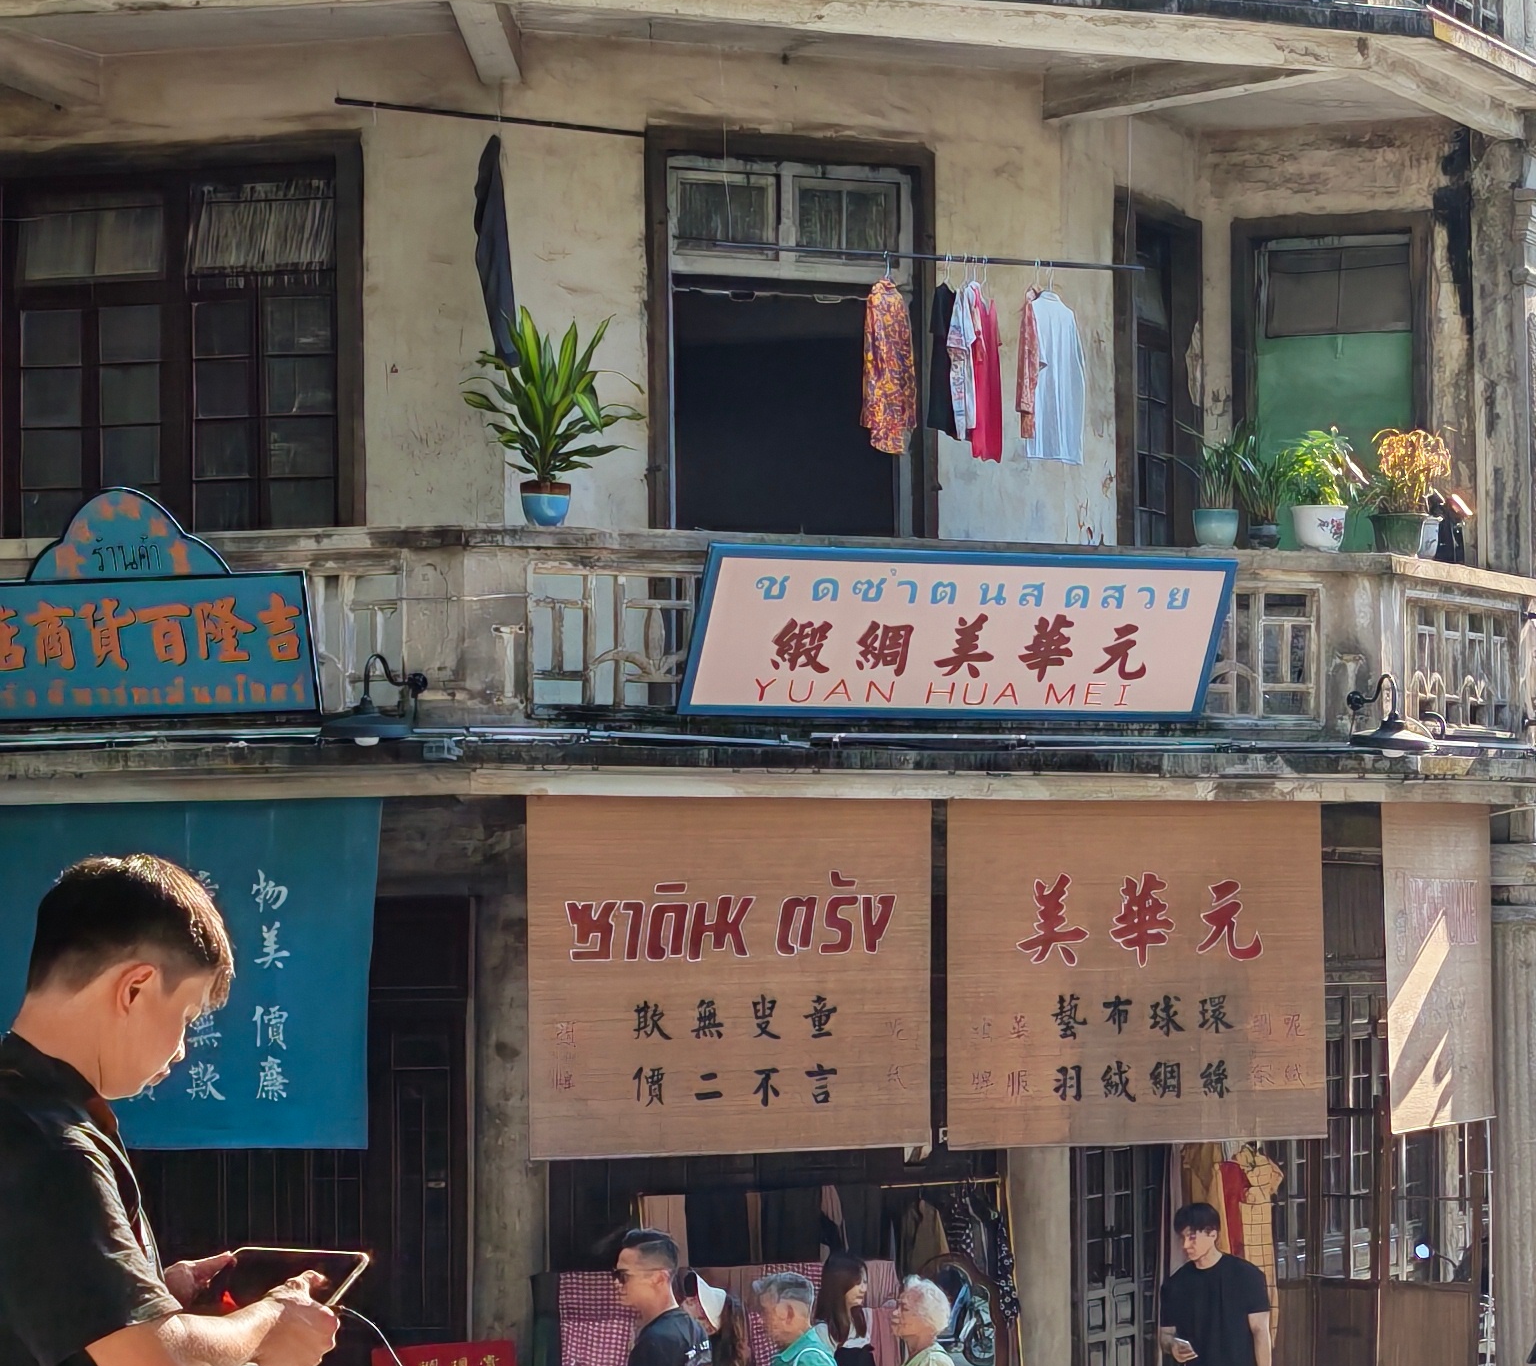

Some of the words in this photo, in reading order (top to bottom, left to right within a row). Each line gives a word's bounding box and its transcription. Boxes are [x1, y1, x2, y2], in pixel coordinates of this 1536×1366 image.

[755, 678, 895, 704] YUAN
[925, 681, 1020, 707] HUA
[1044, 682, 1131, 708] MEI
